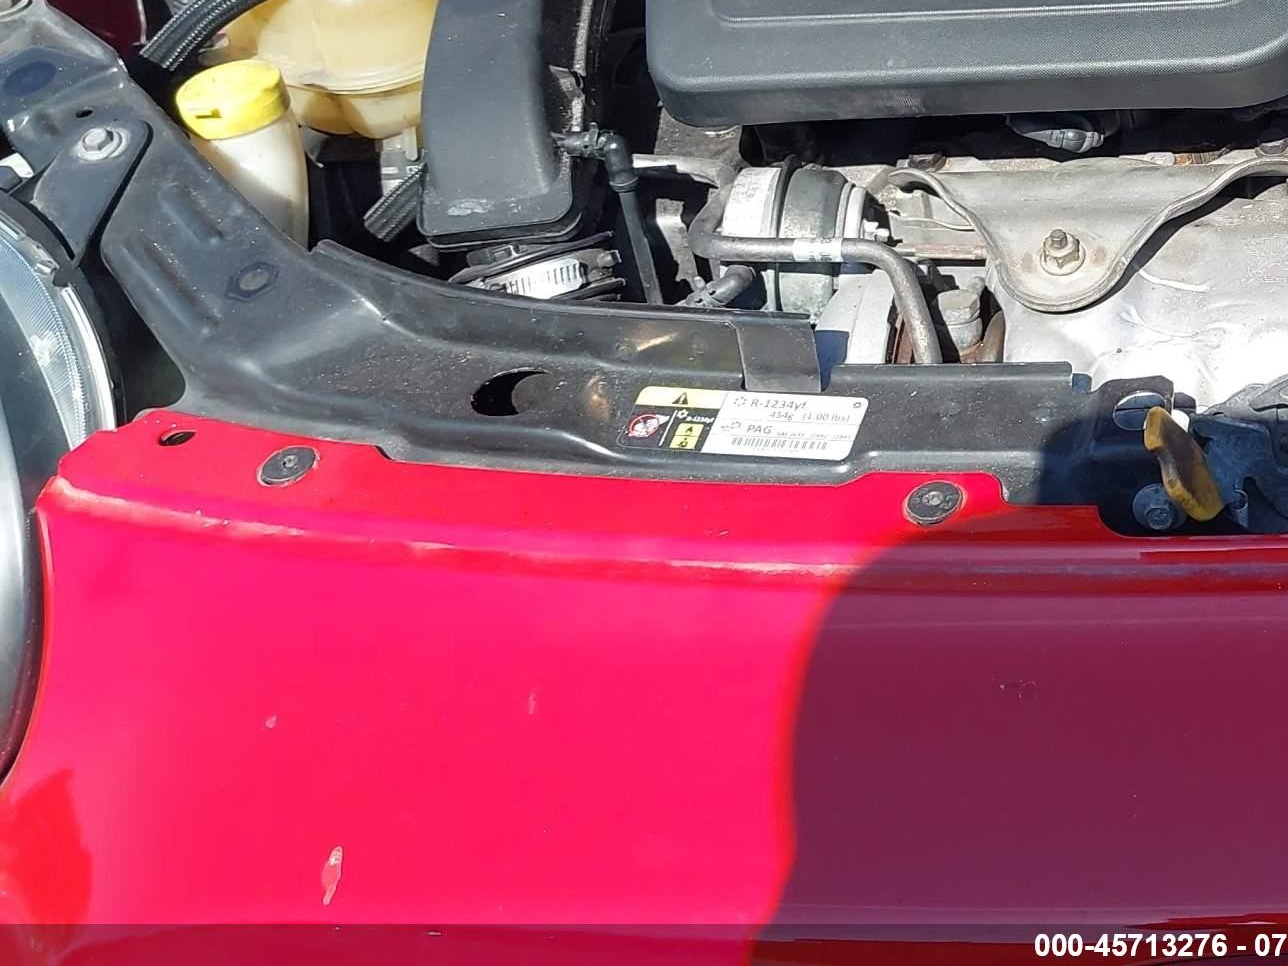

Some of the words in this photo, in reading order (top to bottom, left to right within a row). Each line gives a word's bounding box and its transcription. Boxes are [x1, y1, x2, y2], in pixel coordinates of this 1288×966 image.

[750, 398, 807, 411] R-1234yf
[769, 410, 795, 422] 454g
[746, 423, 773, 435] PAG
